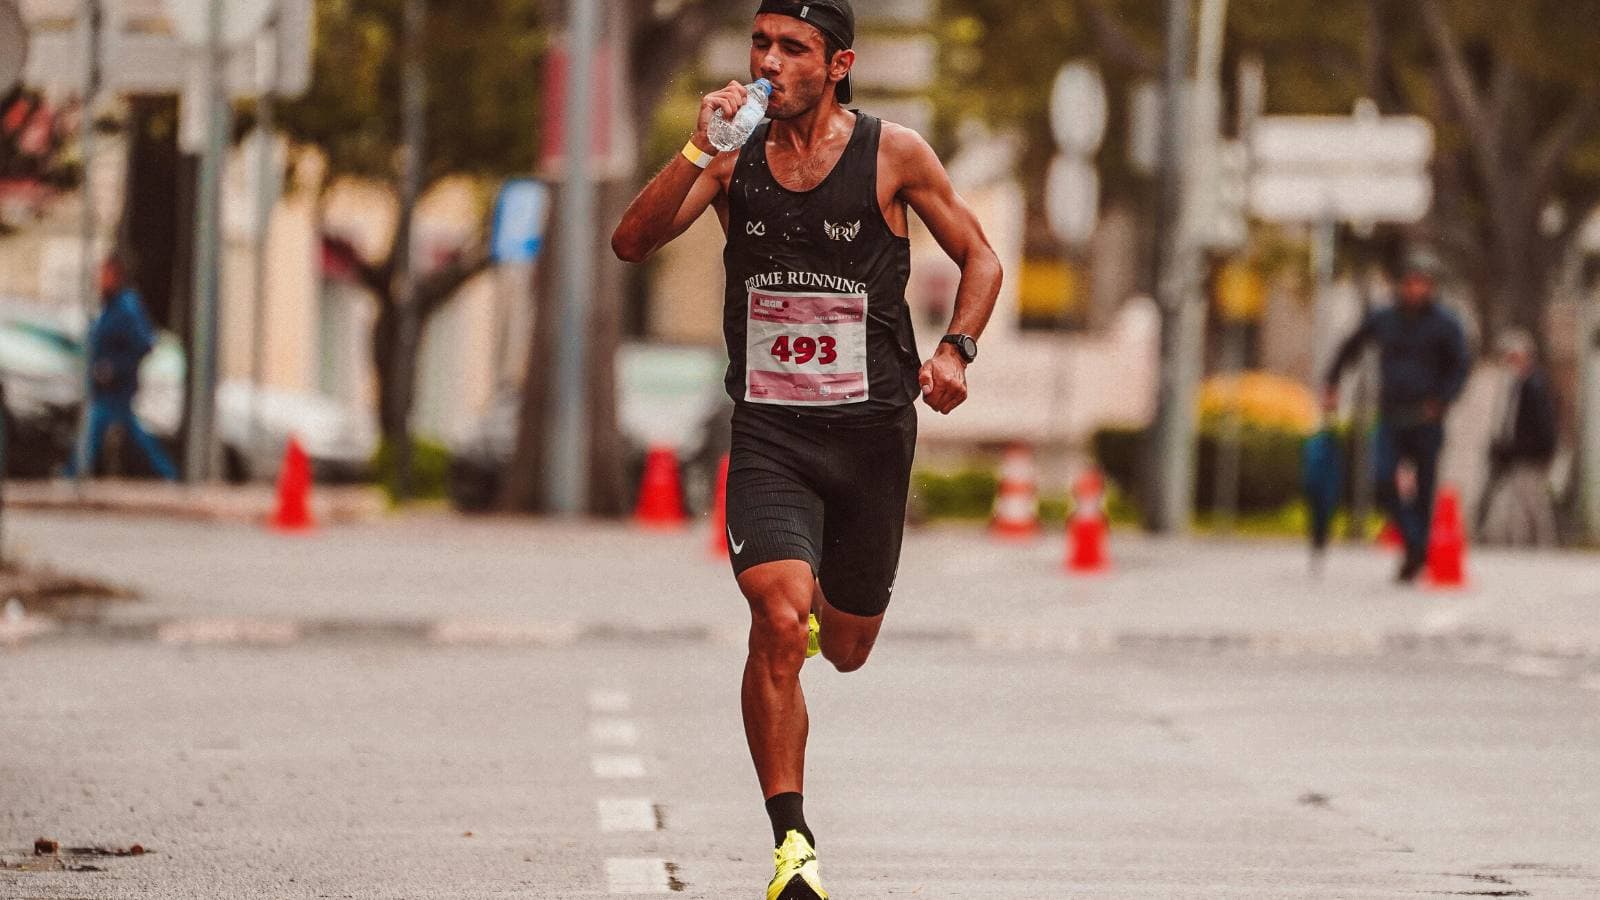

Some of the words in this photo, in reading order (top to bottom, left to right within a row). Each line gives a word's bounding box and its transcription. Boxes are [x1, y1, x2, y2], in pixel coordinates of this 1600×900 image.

[745, 271, 783, 292] PRIME
[787, 271, 866, 294] RUNNING
[771, 335, 838, 365] 493
